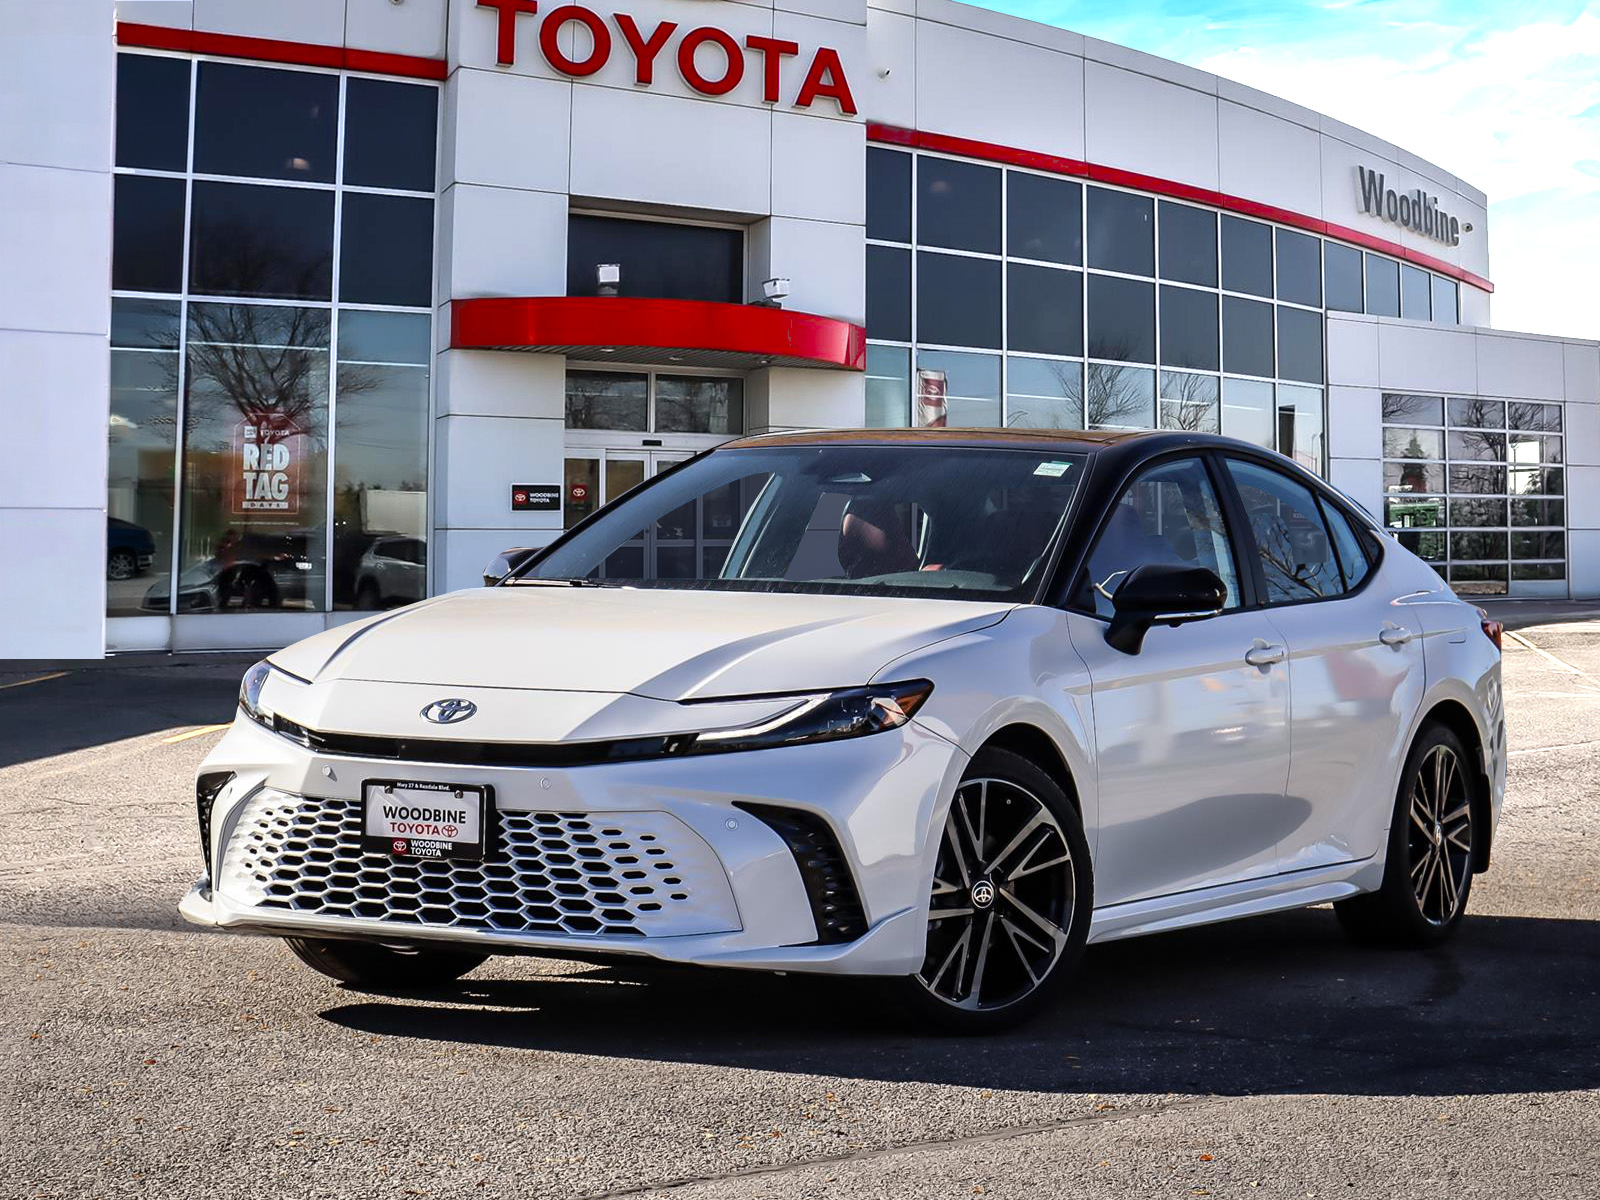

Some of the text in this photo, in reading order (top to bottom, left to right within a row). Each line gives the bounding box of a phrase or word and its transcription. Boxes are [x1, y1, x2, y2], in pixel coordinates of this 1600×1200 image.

[476, 0, 859, 116] TOYOTA
[1352, 165, 1460, 247] Woodbine
[243, 443, 290, 471] RED
[243, 472, 289, 500] TAG
[383, 805, 466, 824] WOODBINE
[390, 822, 441, 836] TOYOTA
[410, 839, 453, 851] WOODBINE
[410, 846, 442, 857] TOYOTA
